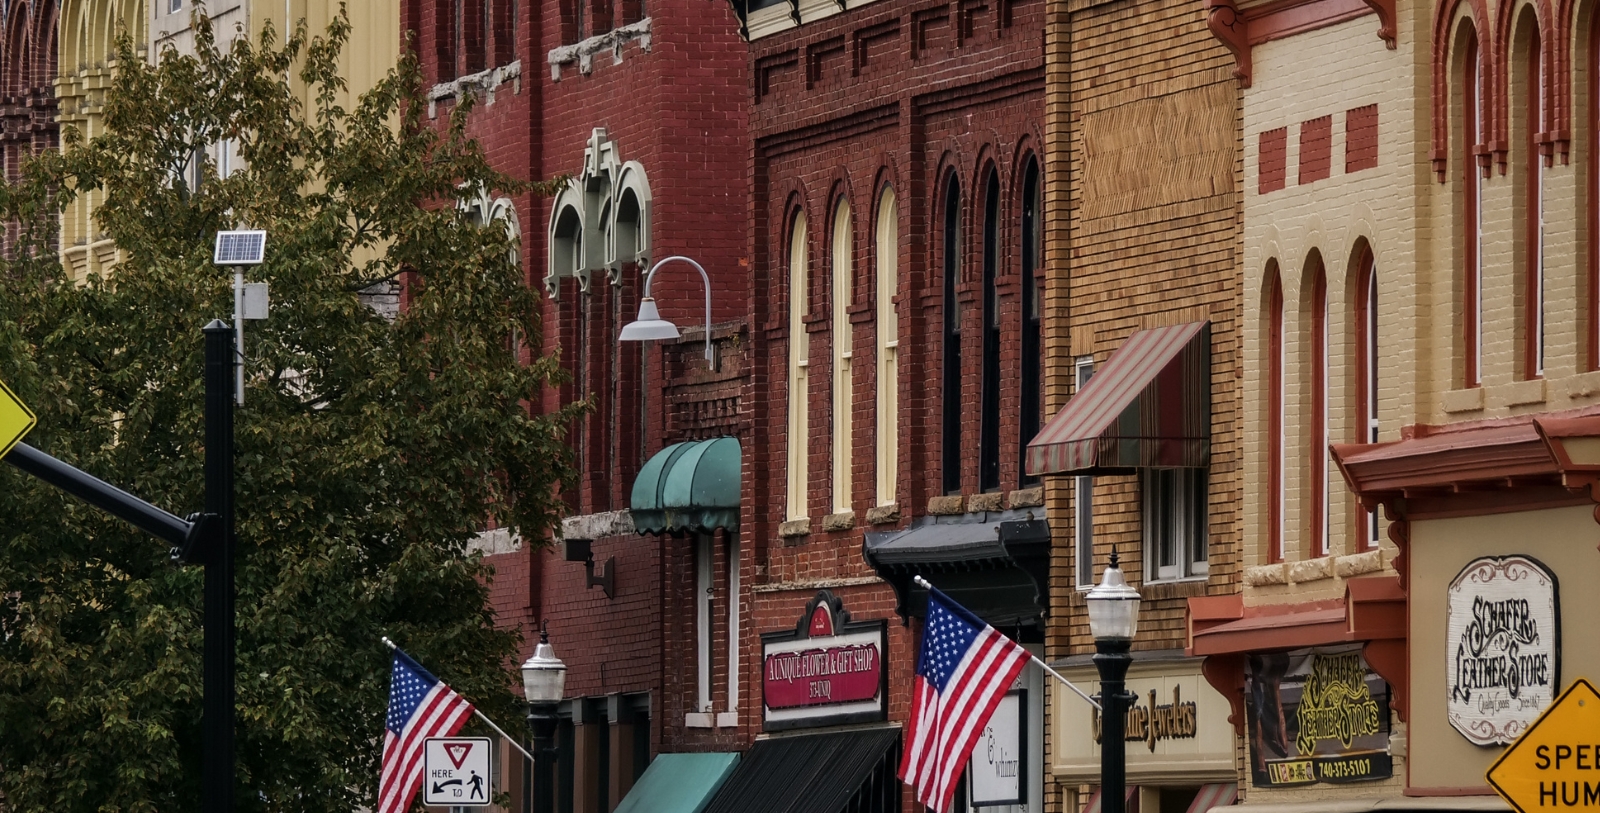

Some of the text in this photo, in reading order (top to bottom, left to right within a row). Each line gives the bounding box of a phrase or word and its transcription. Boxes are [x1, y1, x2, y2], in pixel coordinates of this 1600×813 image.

[1468, 595, 1537, 657] SCHAFER
[802, 652, 830, 677] FLOWER
[831, 653, 836, 674] &
[837, 650, 853, 674] GIFT
[854, 648, 873, 672] SHOP
[1310, 654, 1365, 708] SCHAFER
[1453, 640, 1548, 705] LEATHER STORE
[1147, 685, 1196, 752] Jewelers
[1296, 693, 1379, 755] LEATHER STORE
[431, 769, 453, 778] HERE
[452, 788, 463, 798] TO
[1318, 759, 1371, 778] 740-373-5101
